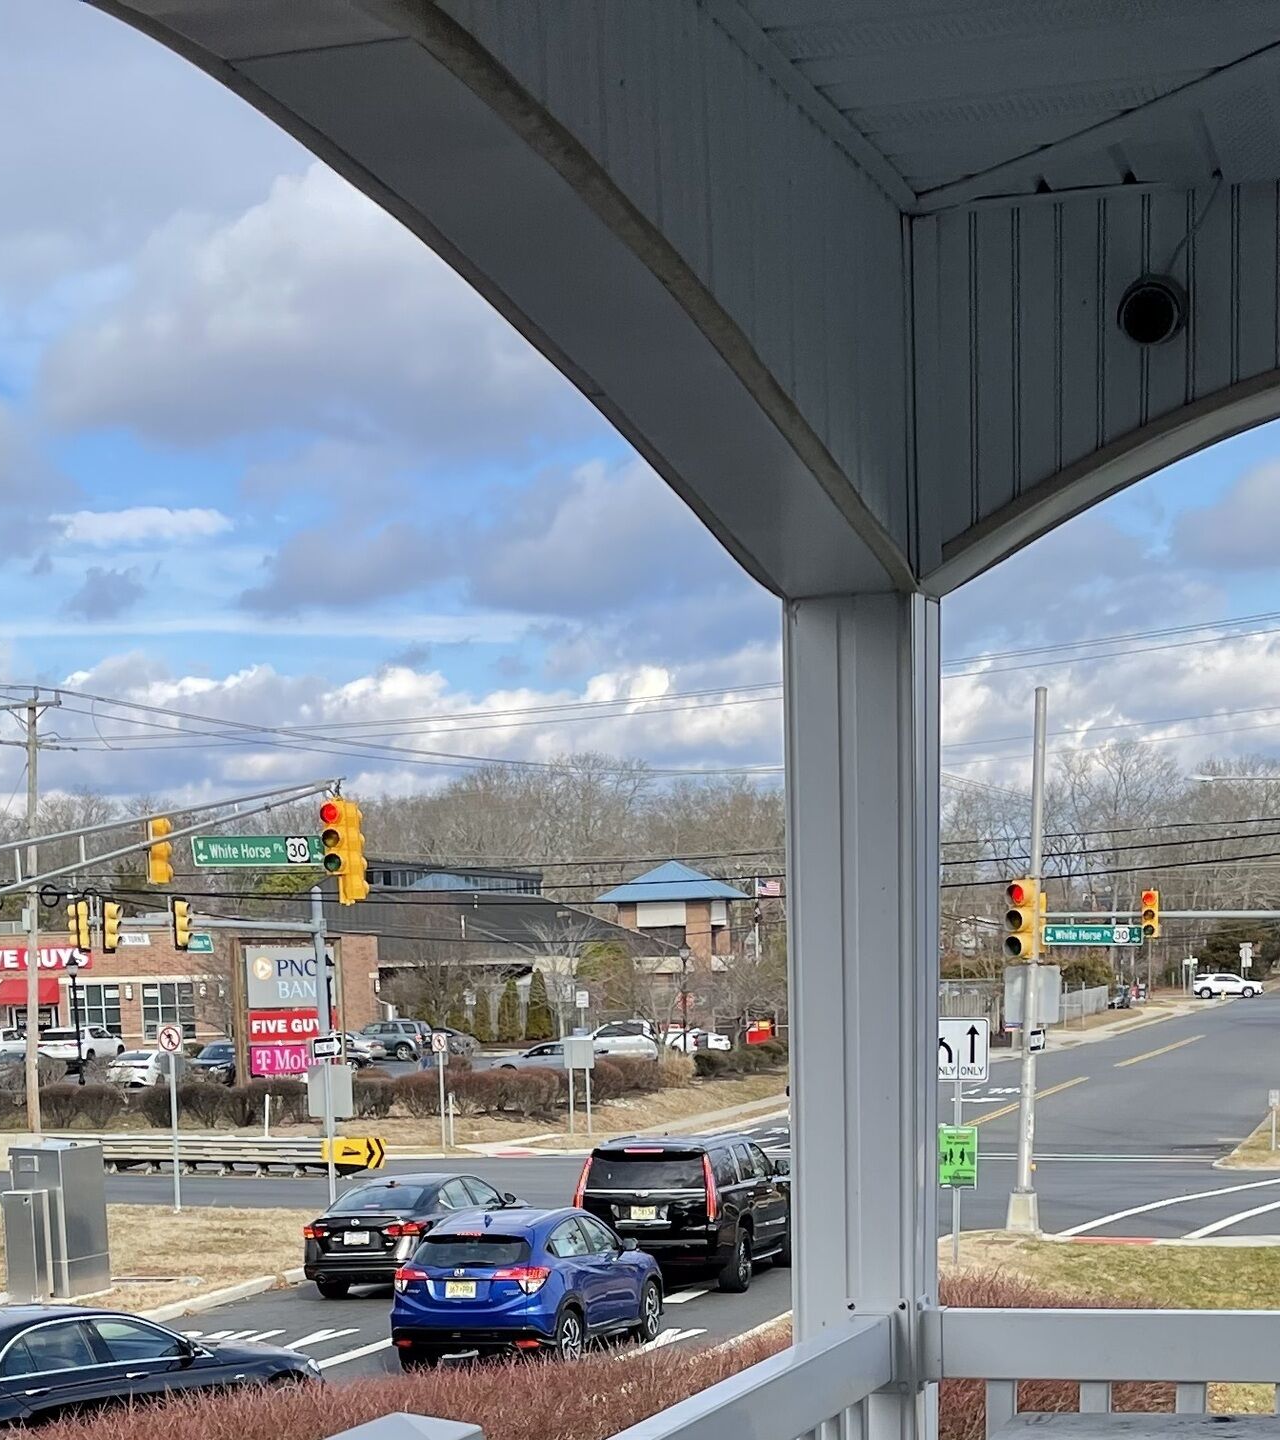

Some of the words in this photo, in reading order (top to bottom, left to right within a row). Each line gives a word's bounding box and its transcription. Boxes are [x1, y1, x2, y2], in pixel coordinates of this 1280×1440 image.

[209, 844, 239, 859] White
[240, 844, 271, 858] Horse
[289, 843, 307, 858] 30
[1055, 930, 1077, 941] White
[1078, 930, 1102, 941] Horse
[1115, 930, 1128, 940] 30
[275, 959, 318, 977] PNC
[276, 980, 317, 998] BAN
[251, 1018, 288, 1034] FIVE
[290, 1018, 320, 1033] GU
[273, 1048, 316, 1070] Mob
[938, 1066, 956, 1076] NLY
[960, 1066, 984, 1076] ONLY
